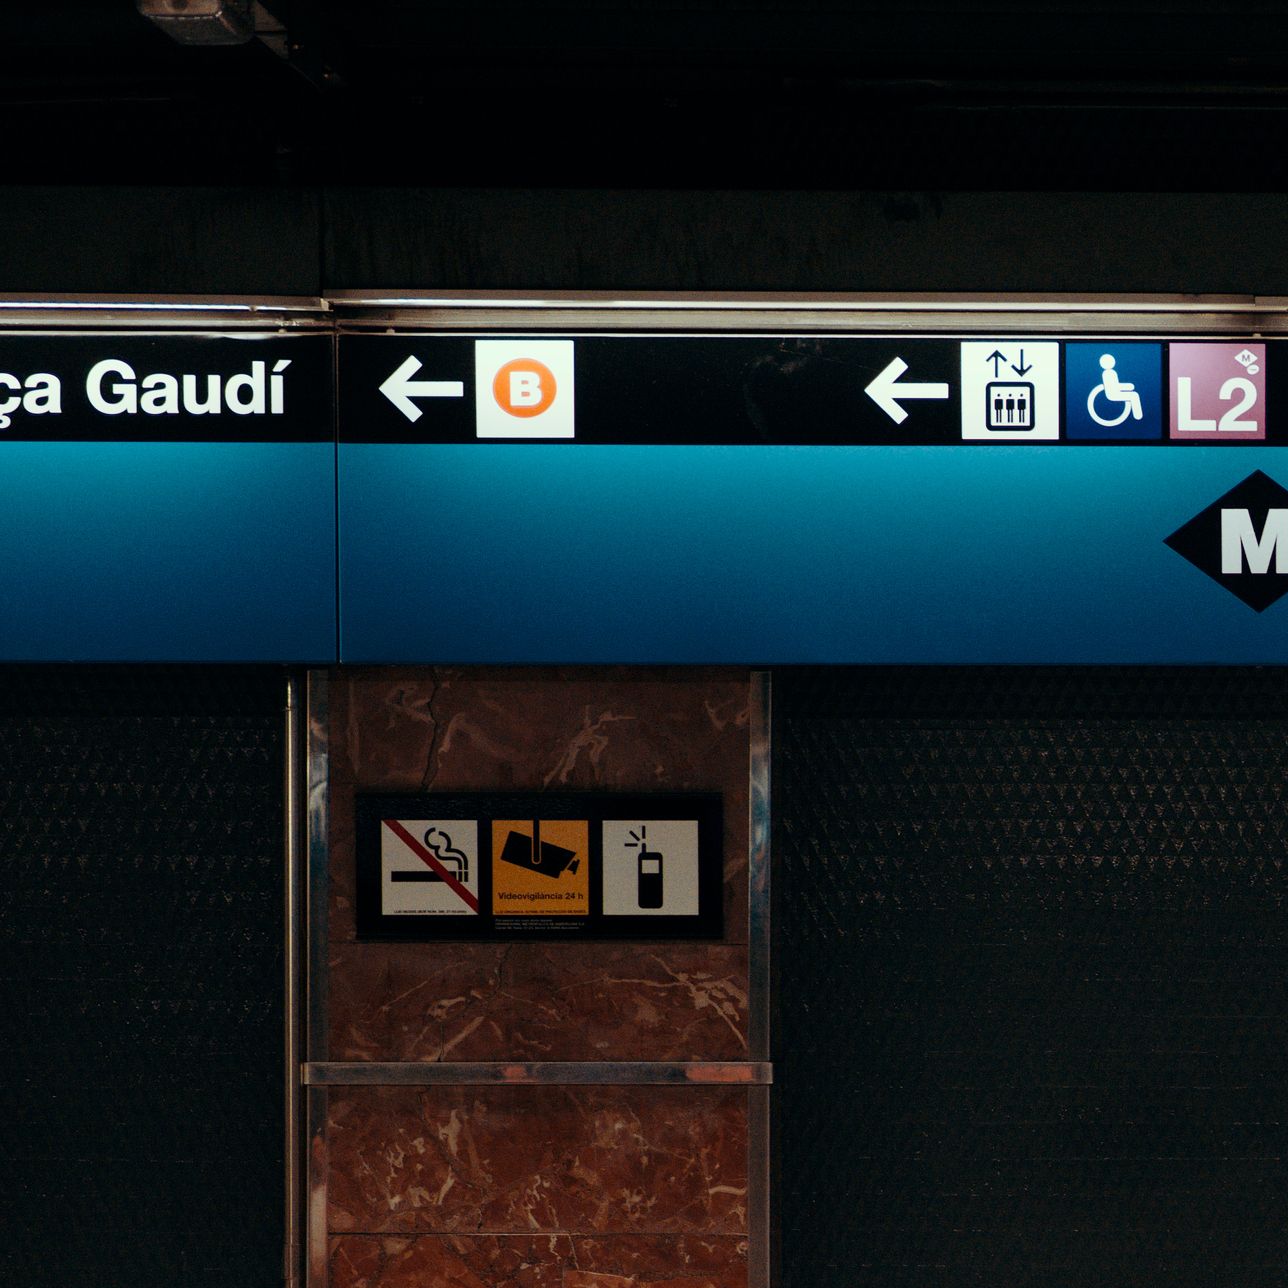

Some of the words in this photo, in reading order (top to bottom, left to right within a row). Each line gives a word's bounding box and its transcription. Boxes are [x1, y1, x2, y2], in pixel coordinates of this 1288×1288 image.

[86, 358, 292, 414] Gaudí
[510, 372, 543, 406] B
[1177, 377, 1258, 431] L2
[565, 892, 575, 900] 24
[578, 892, 584, 900] h
